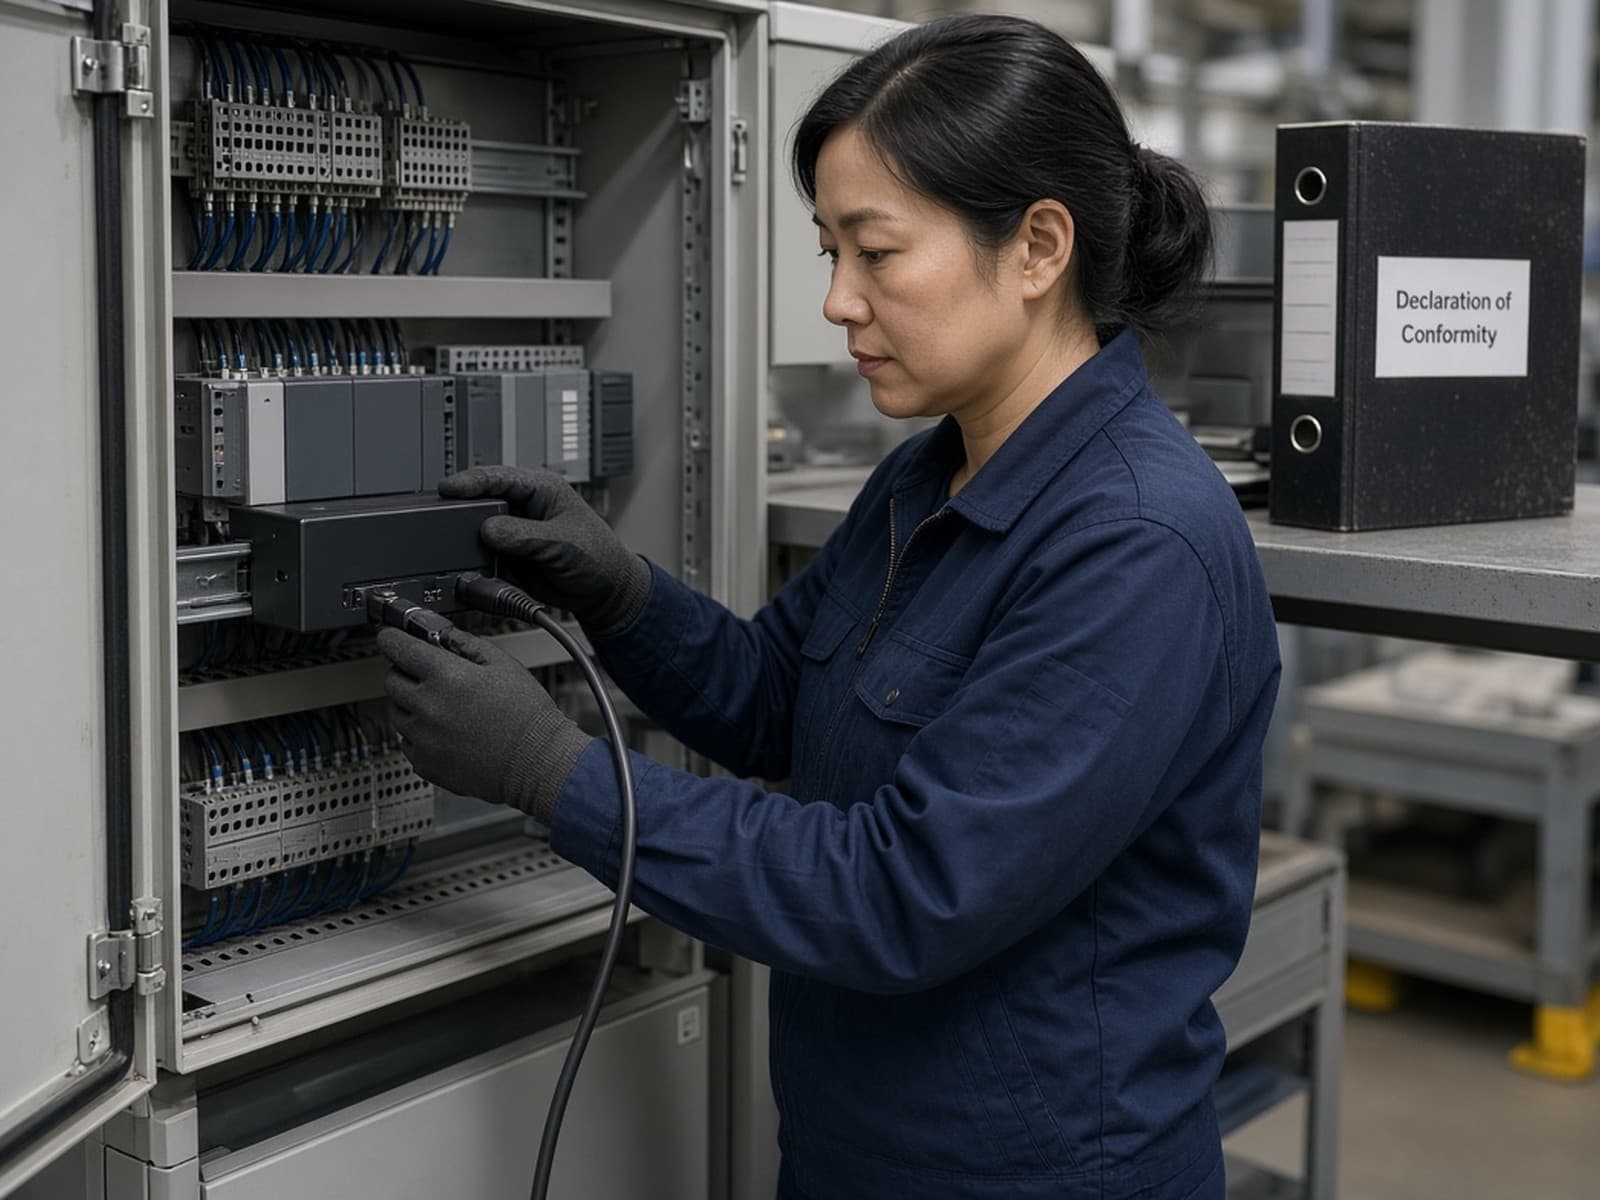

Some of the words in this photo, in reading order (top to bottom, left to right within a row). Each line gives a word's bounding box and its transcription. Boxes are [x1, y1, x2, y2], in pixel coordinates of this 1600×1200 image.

[1396, 290, 1491, 310] Declaration
[1495, 290, 1512, 310] of
[1401, 324, 1497, 348] Conformity
